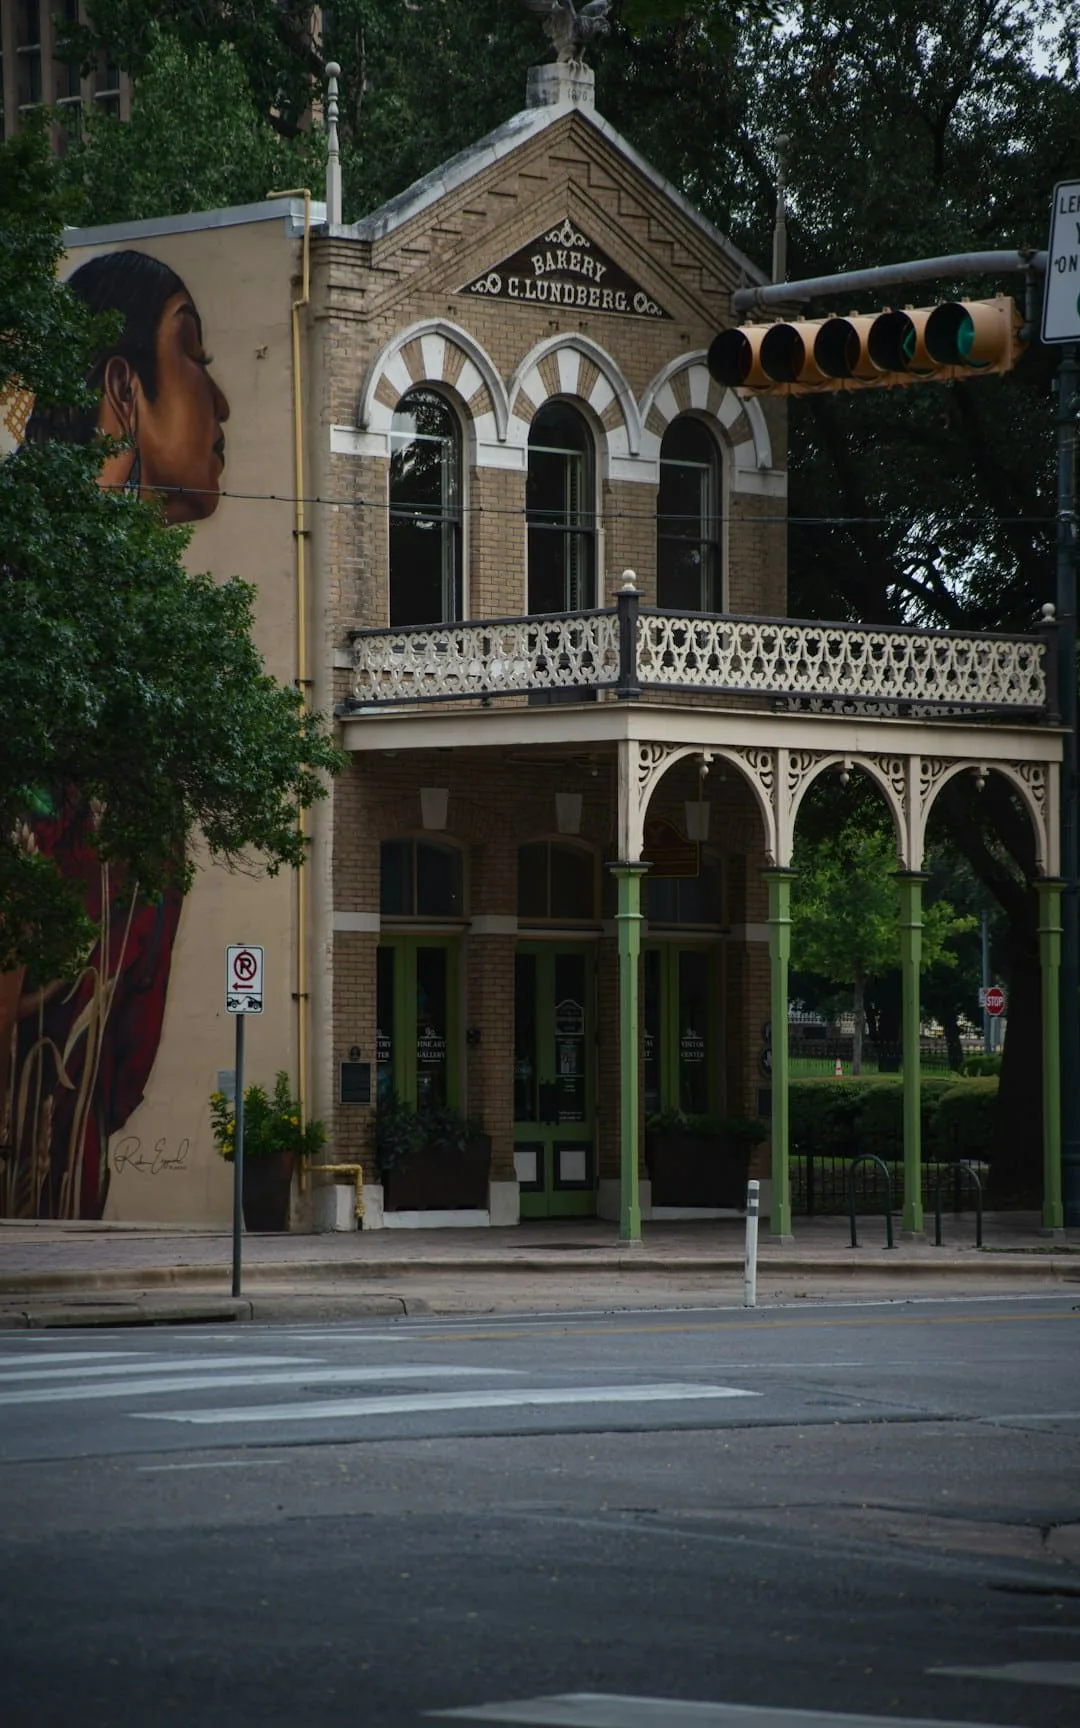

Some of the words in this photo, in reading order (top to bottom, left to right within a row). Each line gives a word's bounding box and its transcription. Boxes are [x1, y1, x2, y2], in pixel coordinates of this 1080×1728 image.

[531, 250, 607, 283] BAKERY
[986, 996, 1003, 1007] STOP
[681, 1040, 704, 1048] VISITOR
